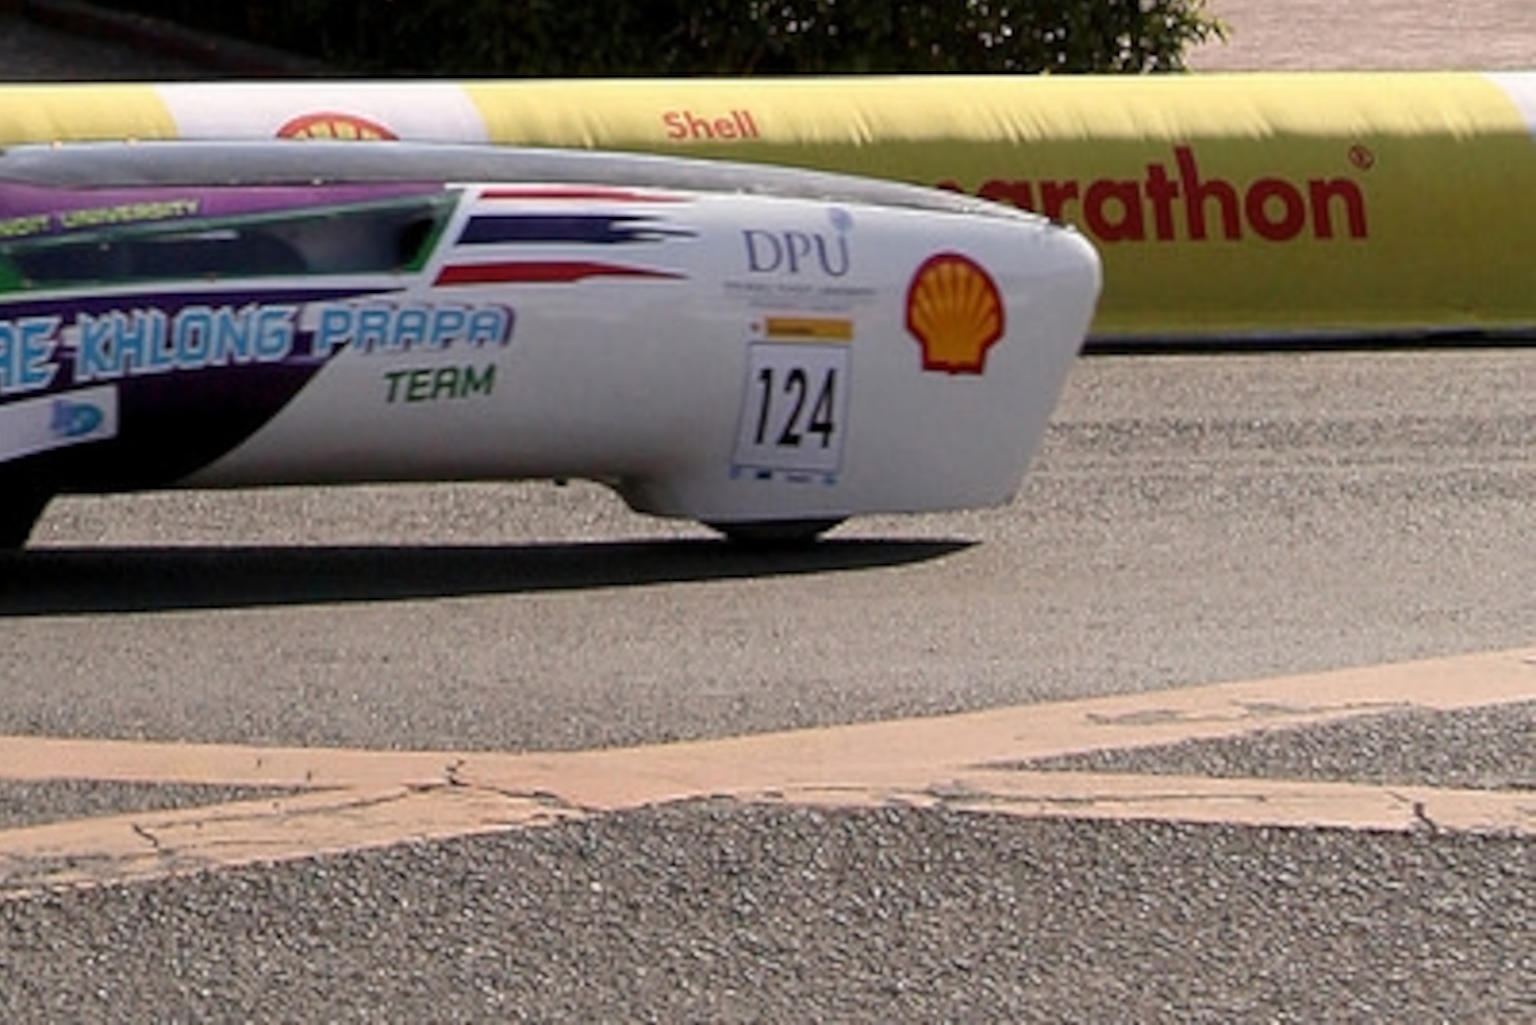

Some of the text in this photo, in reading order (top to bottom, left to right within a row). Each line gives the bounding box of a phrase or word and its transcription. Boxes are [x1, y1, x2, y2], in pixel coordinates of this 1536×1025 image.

[662, 110, 760, 139] Shell
[60, 198, 199, 228] UNIVERSITY
[741, 228, 851, 276] DPU
[76, 302, 300, 381] KHLONG
[312, 303, 514, 357] PRAPA
[384, 365, 496, 403] TEAM
[754, 367, 837, 449] 124
